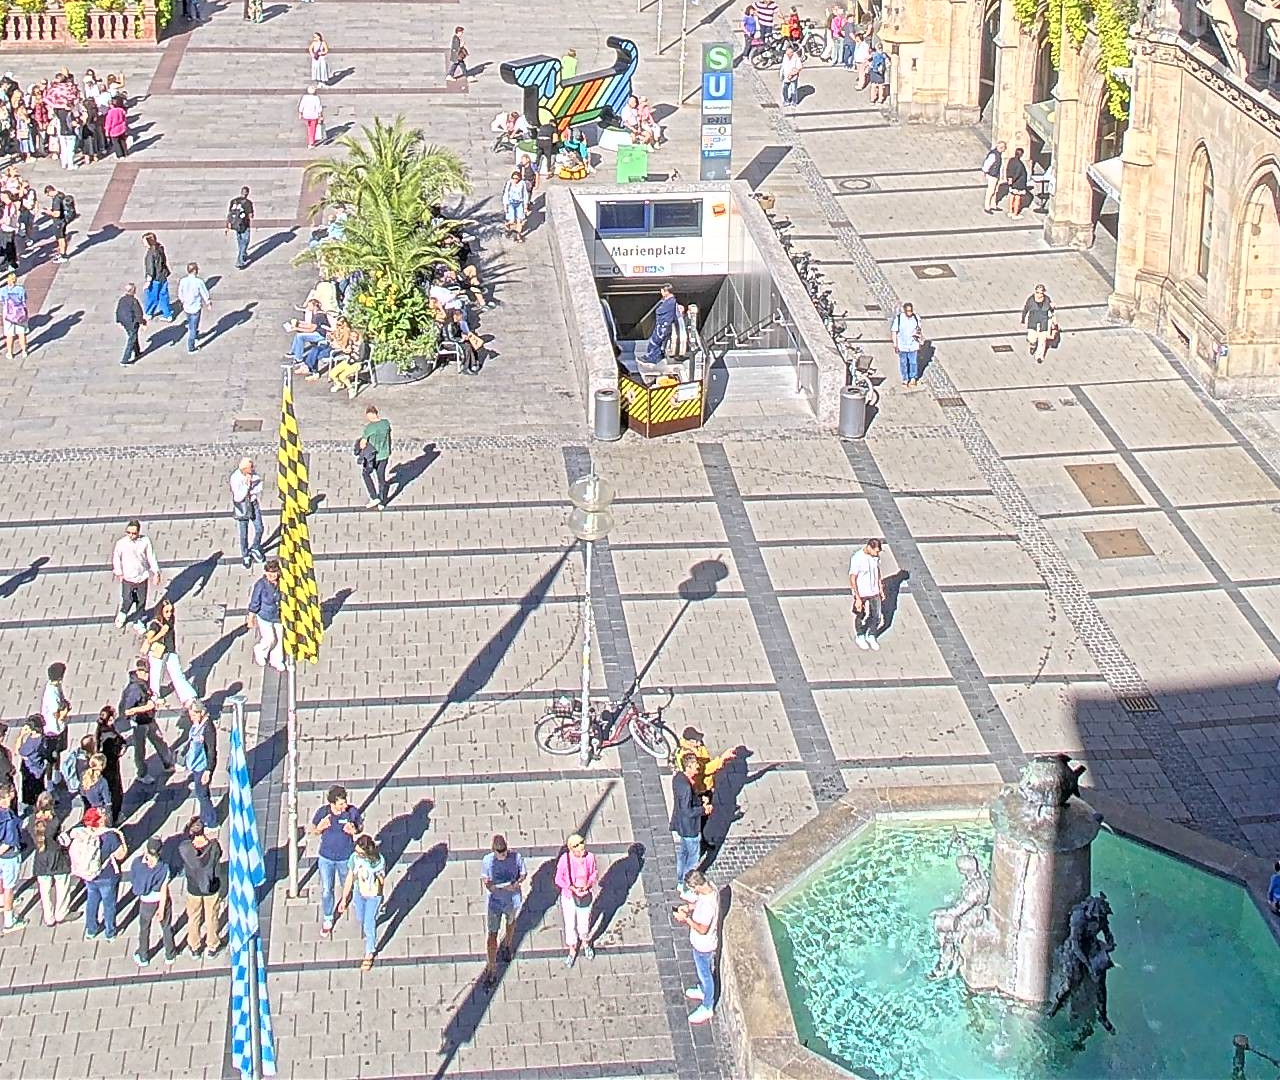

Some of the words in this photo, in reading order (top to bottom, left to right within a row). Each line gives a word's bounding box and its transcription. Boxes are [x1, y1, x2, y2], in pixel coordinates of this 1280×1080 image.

[709, 46, 728, 70] S
[708, 75, 726, 97] U
[610, 244, 687, 259] Marienplatz
